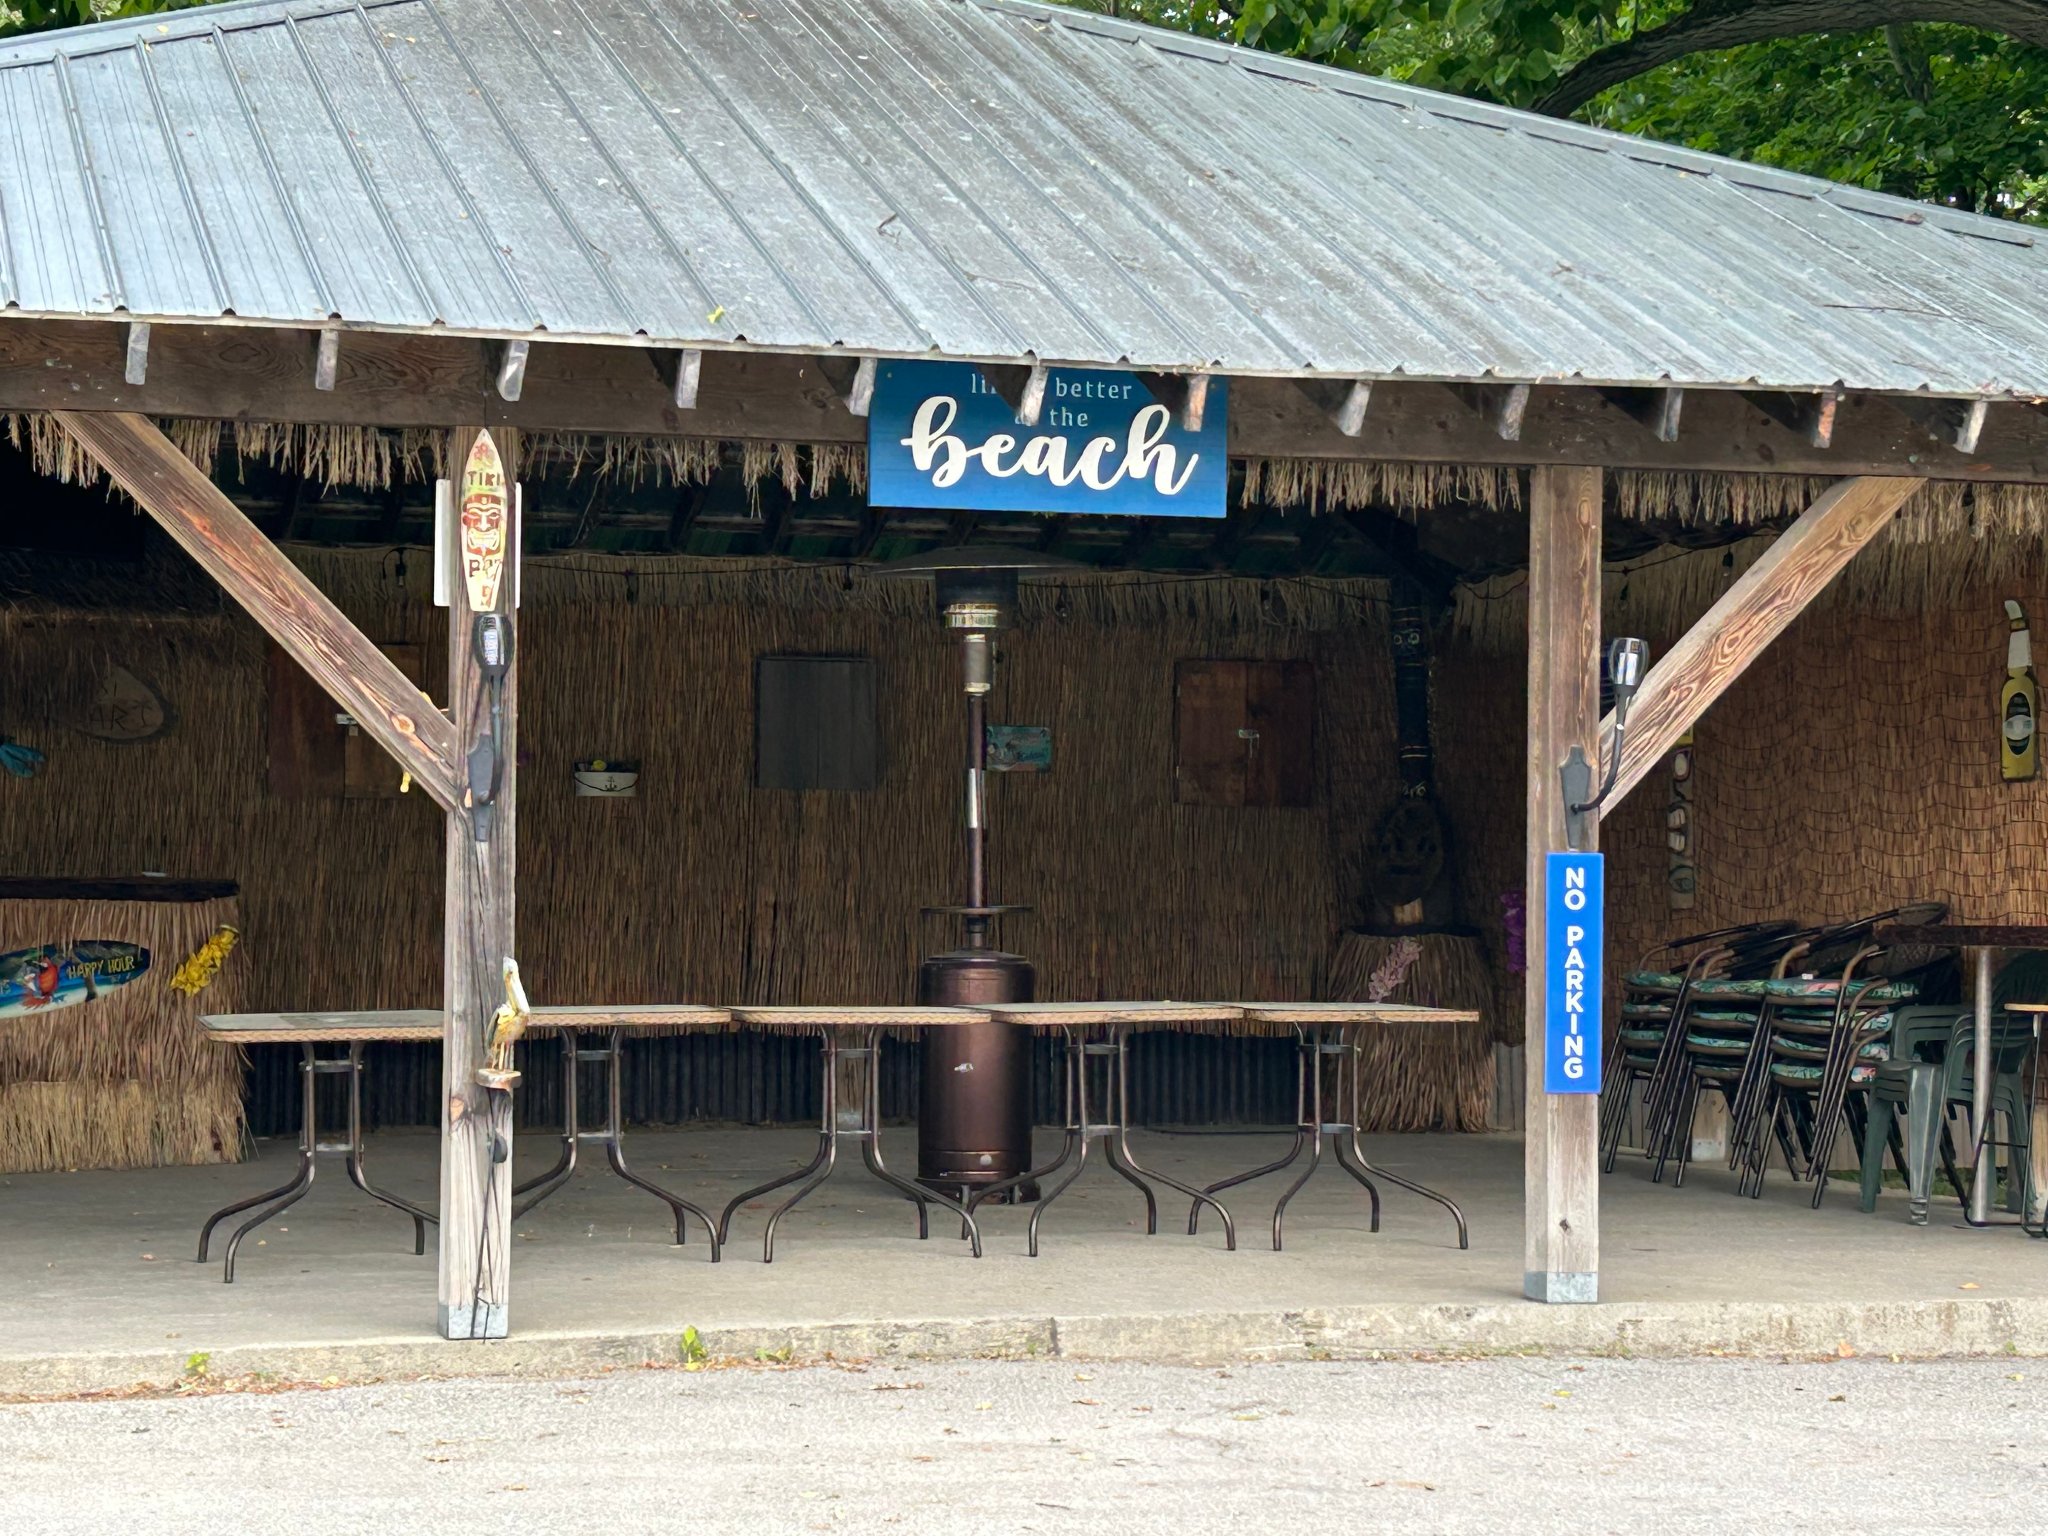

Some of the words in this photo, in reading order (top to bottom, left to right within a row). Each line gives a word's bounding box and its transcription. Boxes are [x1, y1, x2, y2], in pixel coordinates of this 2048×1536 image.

[1055, 377, 1132, 400] better
[1049, 406, 1089, 428] the
[900, 395, 1199, 496] beach
[467, 470, 501, 487] TIKI
[1564, 867, 1586, 911] NO
[66, 959, 104, 979] HAPPY
[107, 955, 135, 974] HOUR
[1563, 925, 1585, 1079] PARKING
